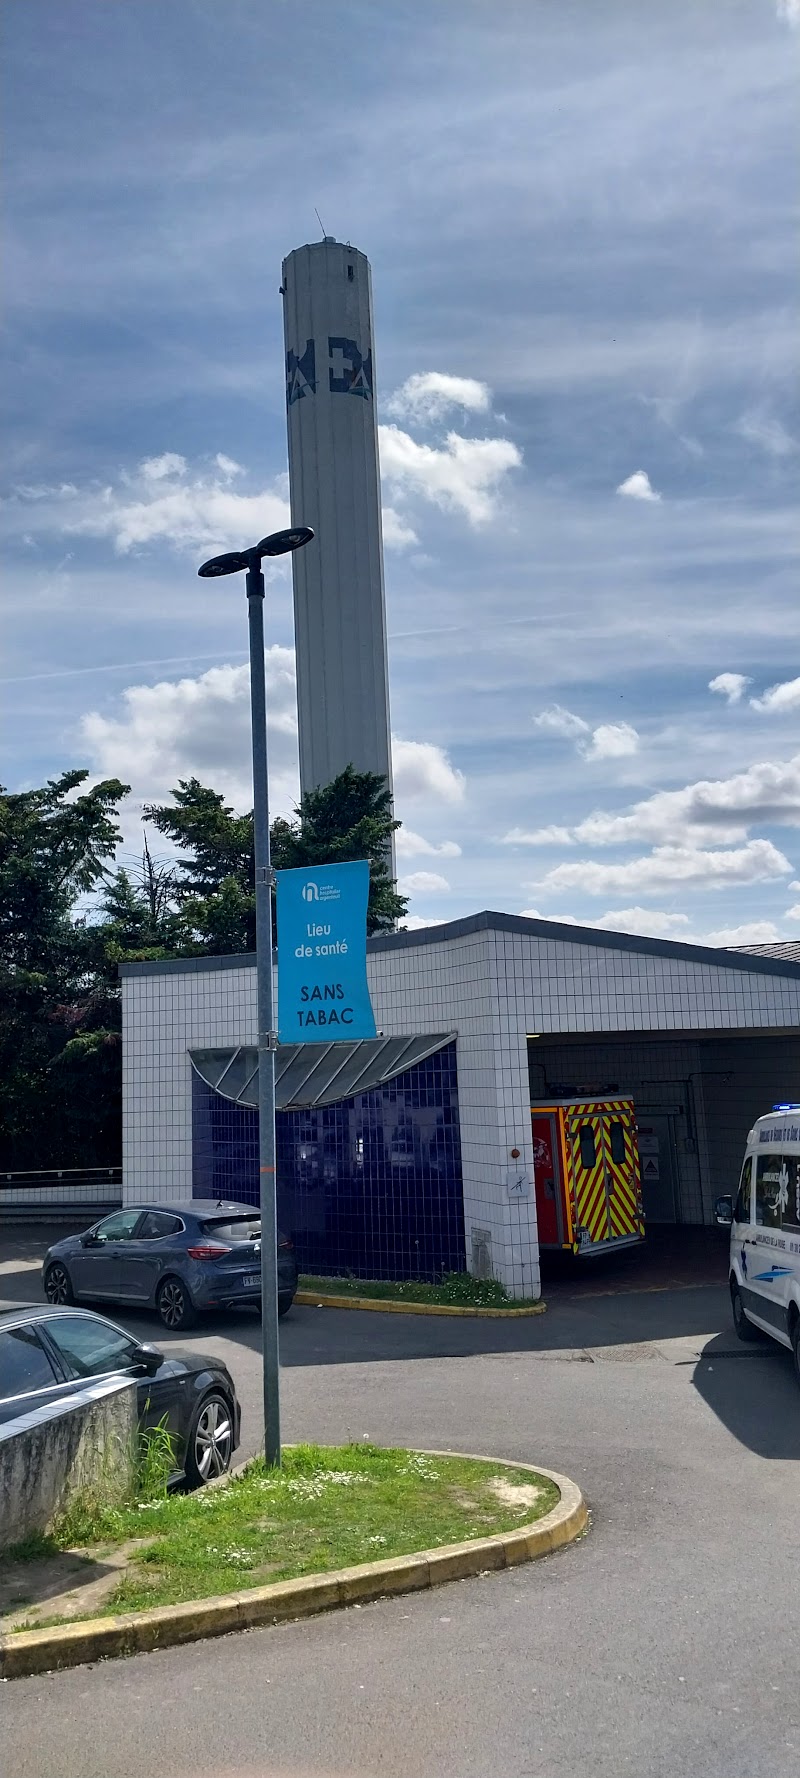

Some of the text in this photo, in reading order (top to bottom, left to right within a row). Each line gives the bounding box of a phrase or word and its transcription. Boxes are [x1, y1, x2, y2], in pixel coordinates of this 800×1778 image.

[307, 923, 331, 937] Lieu
[295, 939, 348, 958] de santé
[300, 983, 345, 1002] SANS
[297, 1007, 354, 1026] TABAC
